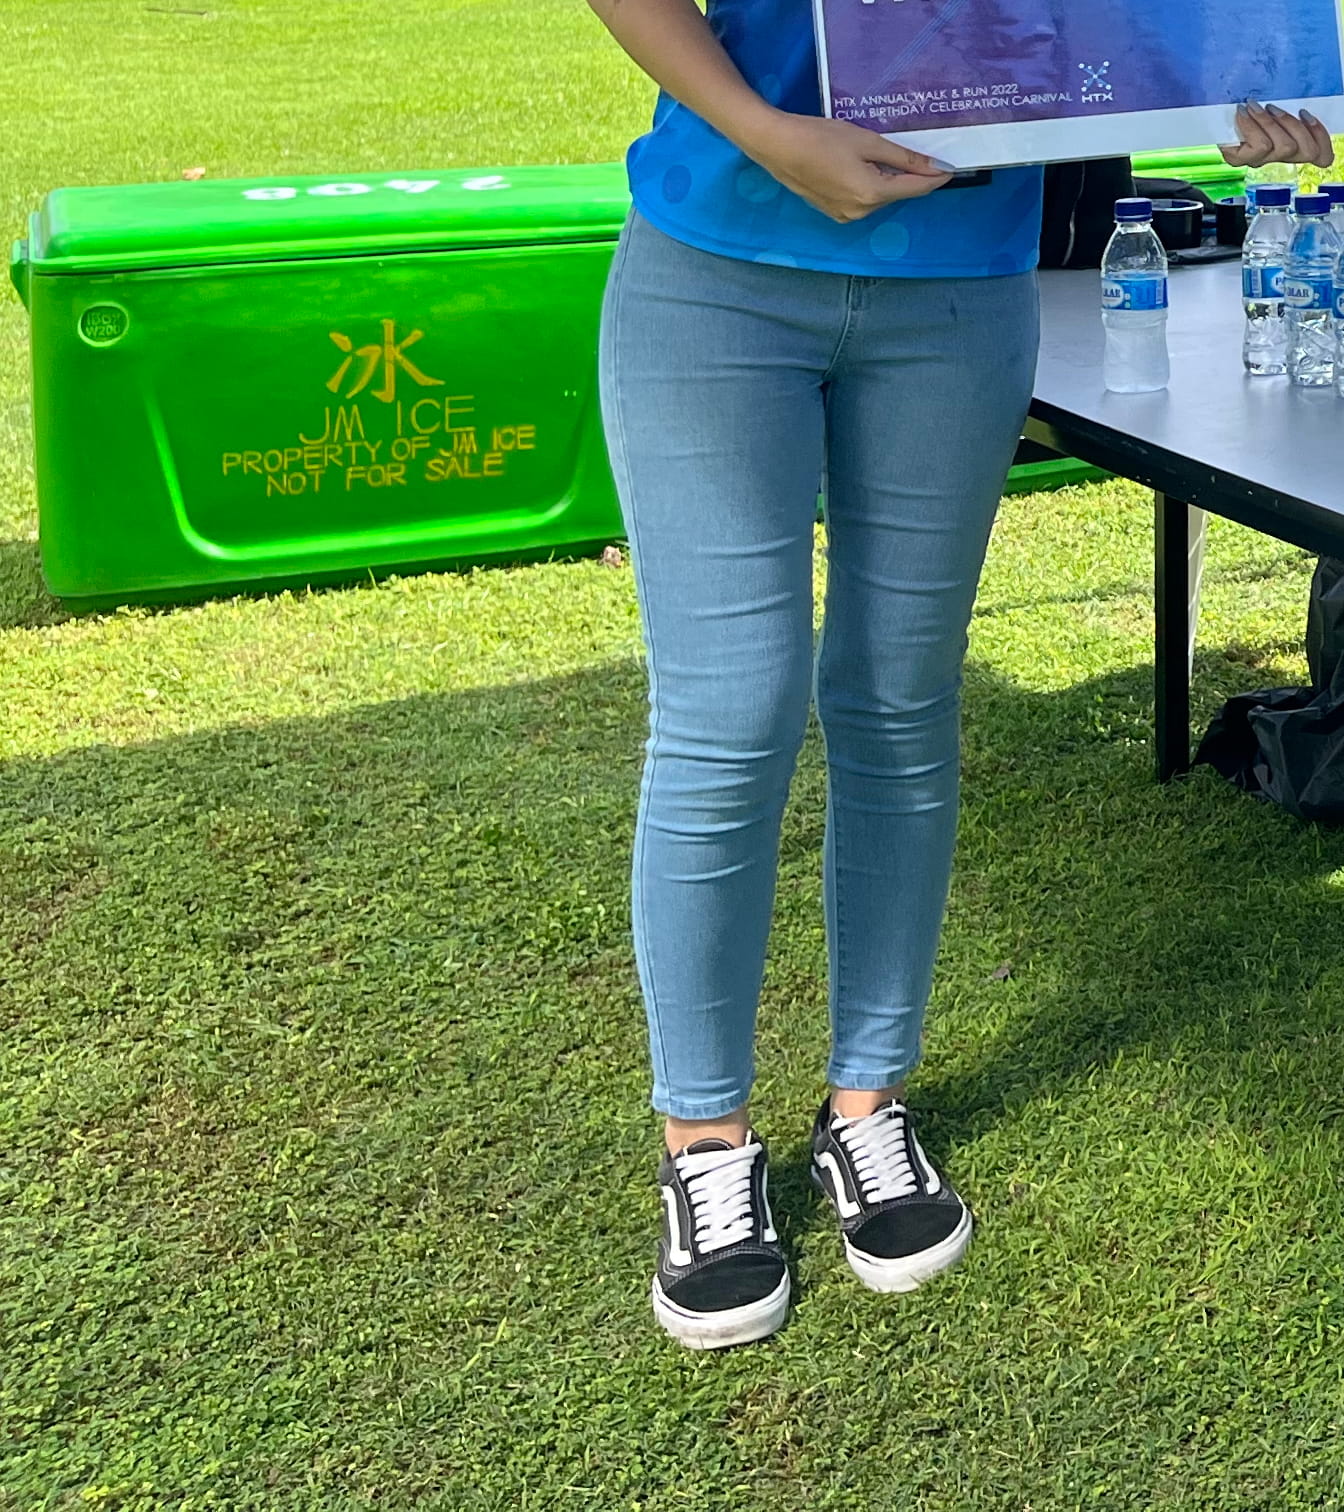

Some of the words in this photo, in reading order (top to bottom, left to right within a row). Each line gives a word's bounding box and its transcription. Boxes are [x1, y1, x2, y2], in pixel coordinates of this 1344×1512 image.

[834, 97, 857, 109] HTX
[860, 92, 911, 106] ANNUAL
[911, 90, 948, 103] WALK
[951, 88, 960, 99] &
[963, 86, 988, 97] RUN
[991, 84, 1019, 95] 2022
[835, 108, 867, 121] CUM
[869, 103, 926, 120] BIRTHDAY
[929, 97, 1009, 114] CELEBRATION
[1011, 92, 1073, 107] CARNIVAL
[1081, 93, 1114, 104] HTX
[325, 318, 446, 403] 冰
[298, 404, 365, 445] JM
[396, 395, 476, 436] ICE
[222, 439, 383, 476] PROPERTY
[391, 436, 431, 462] OF
[492, 424, 536, 452] ICE
[266, 470, 326, 497] NOT
[346, 463, 407, 491] FOR
[424, 453, 504, 481] SALE
